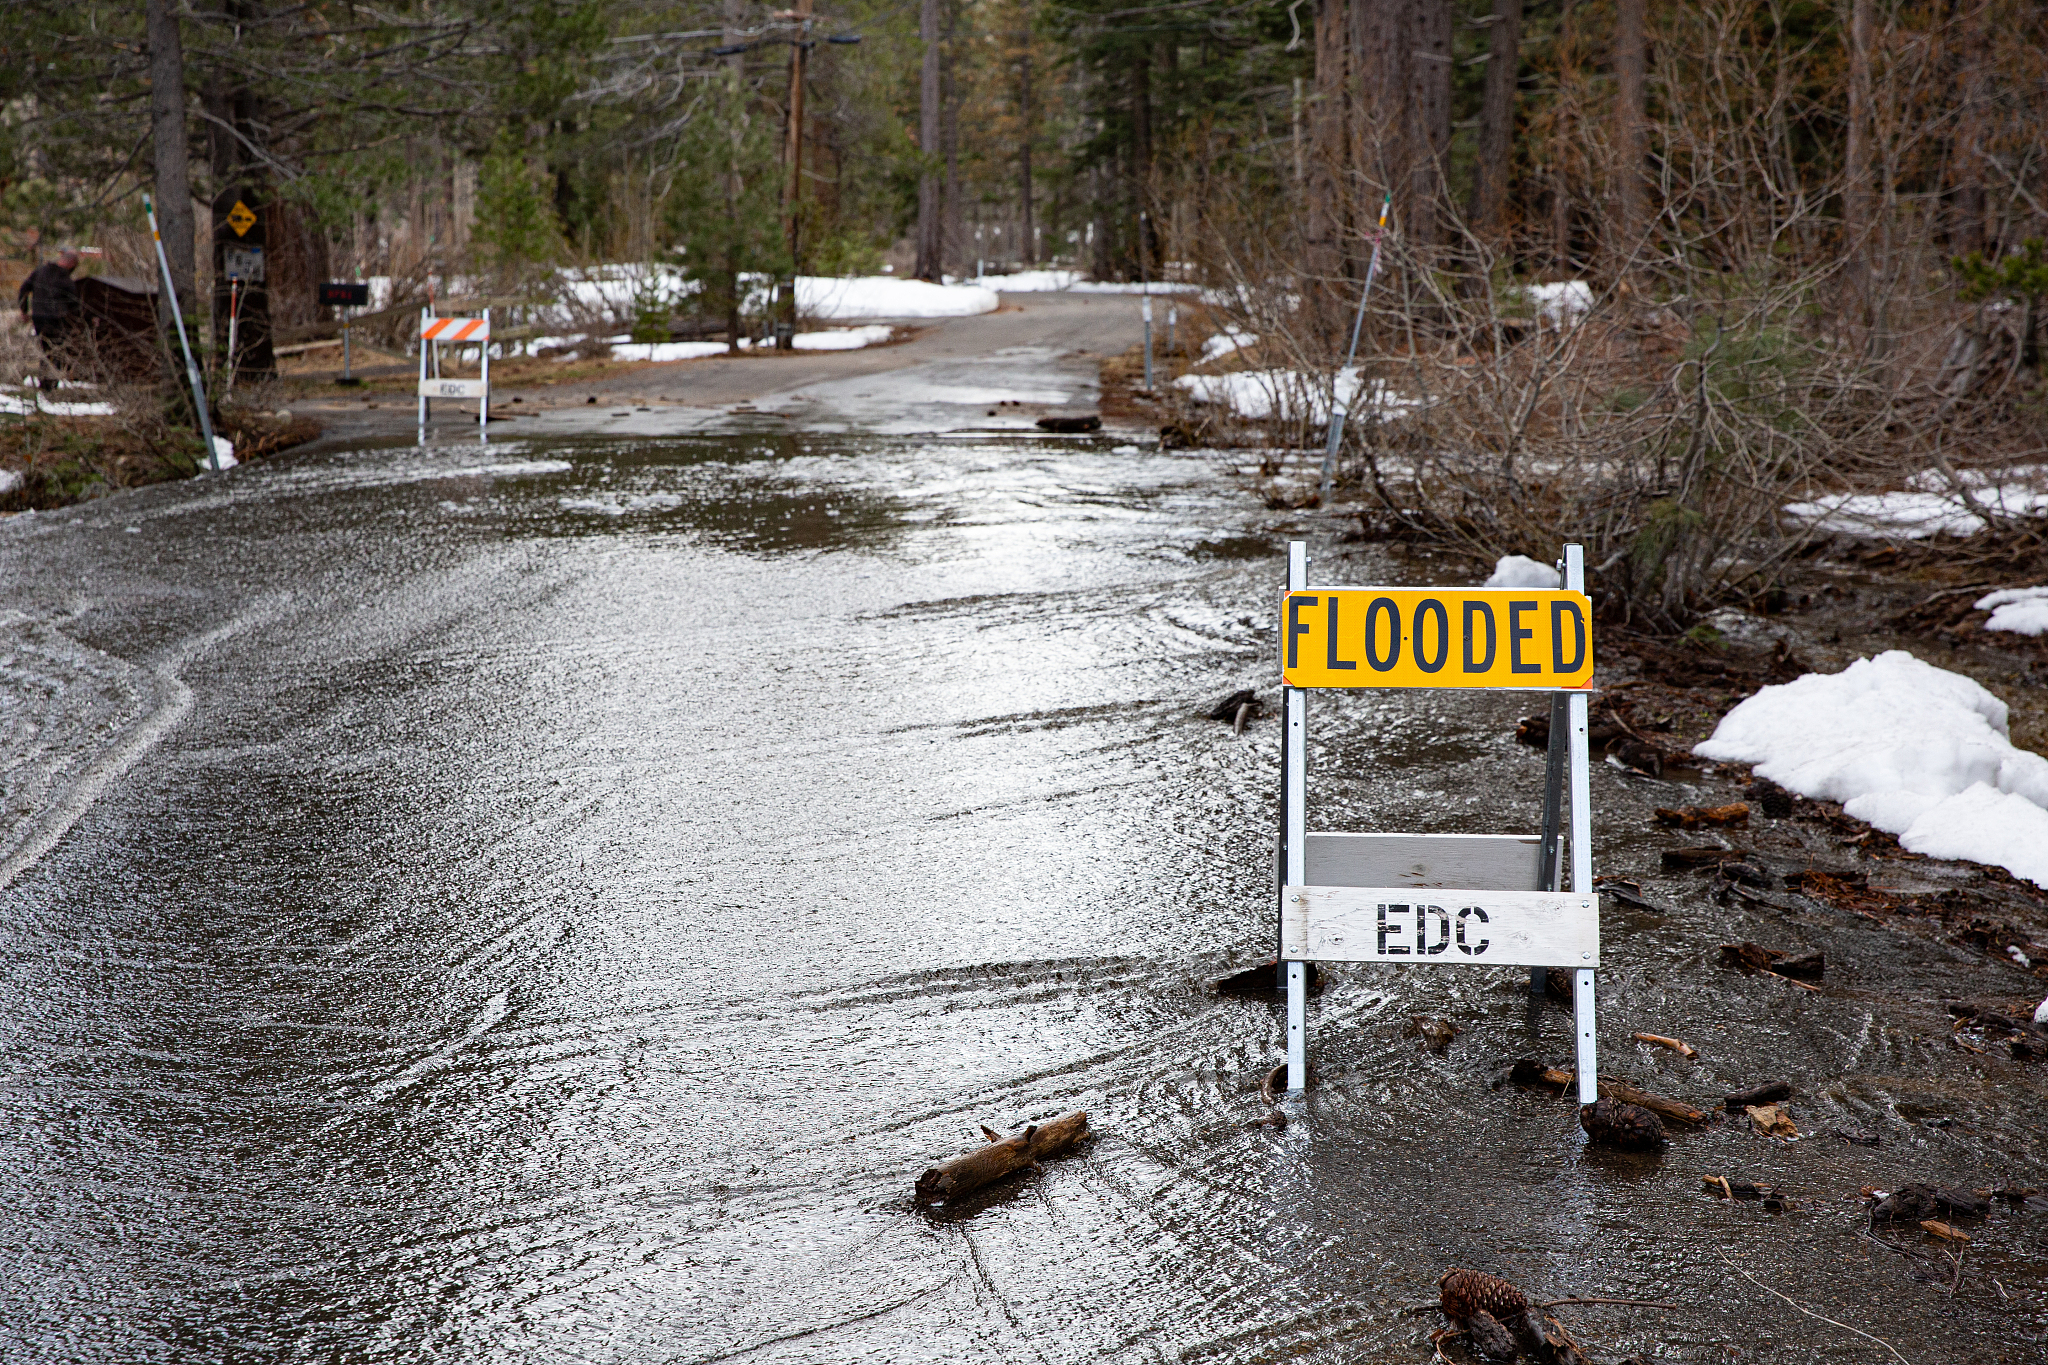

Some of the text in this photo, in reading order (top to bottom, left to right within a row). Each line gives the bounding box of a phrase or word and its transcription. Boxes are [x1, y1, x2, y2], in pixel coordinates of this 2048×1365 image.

[440, 383, 466, 395] EDC
[1287, 595, 1586, 674] FLOODED
[1376, 903, 1490, 956] EDC
